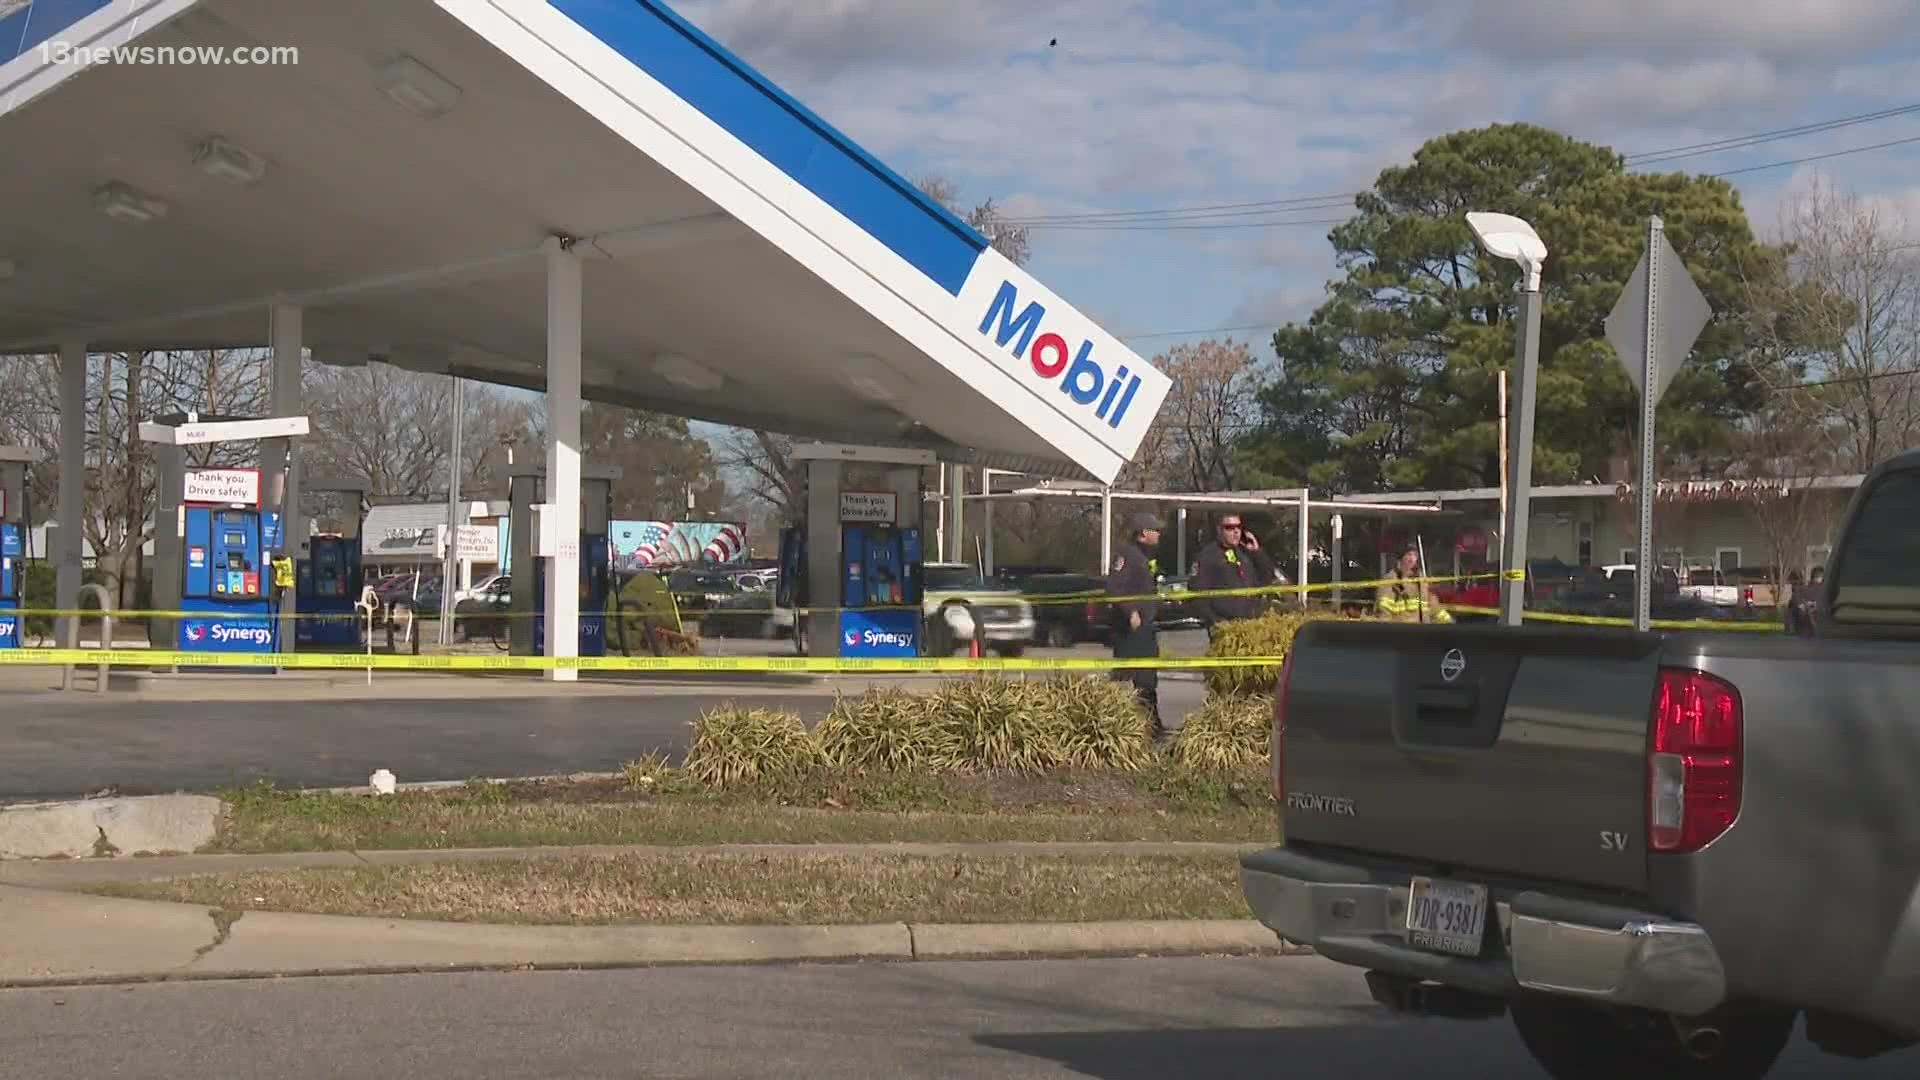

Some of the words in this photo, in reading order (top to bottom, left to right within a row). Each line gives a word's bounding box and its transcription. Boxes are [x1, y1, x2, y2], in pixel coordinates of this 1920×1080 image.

[978, 280, 1142, 429] Mobil
[192, 472, 223, 481] Thank
[188, 485, 215, 495] Drive
[845, 495, 869, 504] Thank
[211, 624, 272, 644] Synergy
[864, 630, 913, 647] Synergy
[1287, 792, 1356, 817] FRONTIER
[1600, 831, 1628, 851] SV
